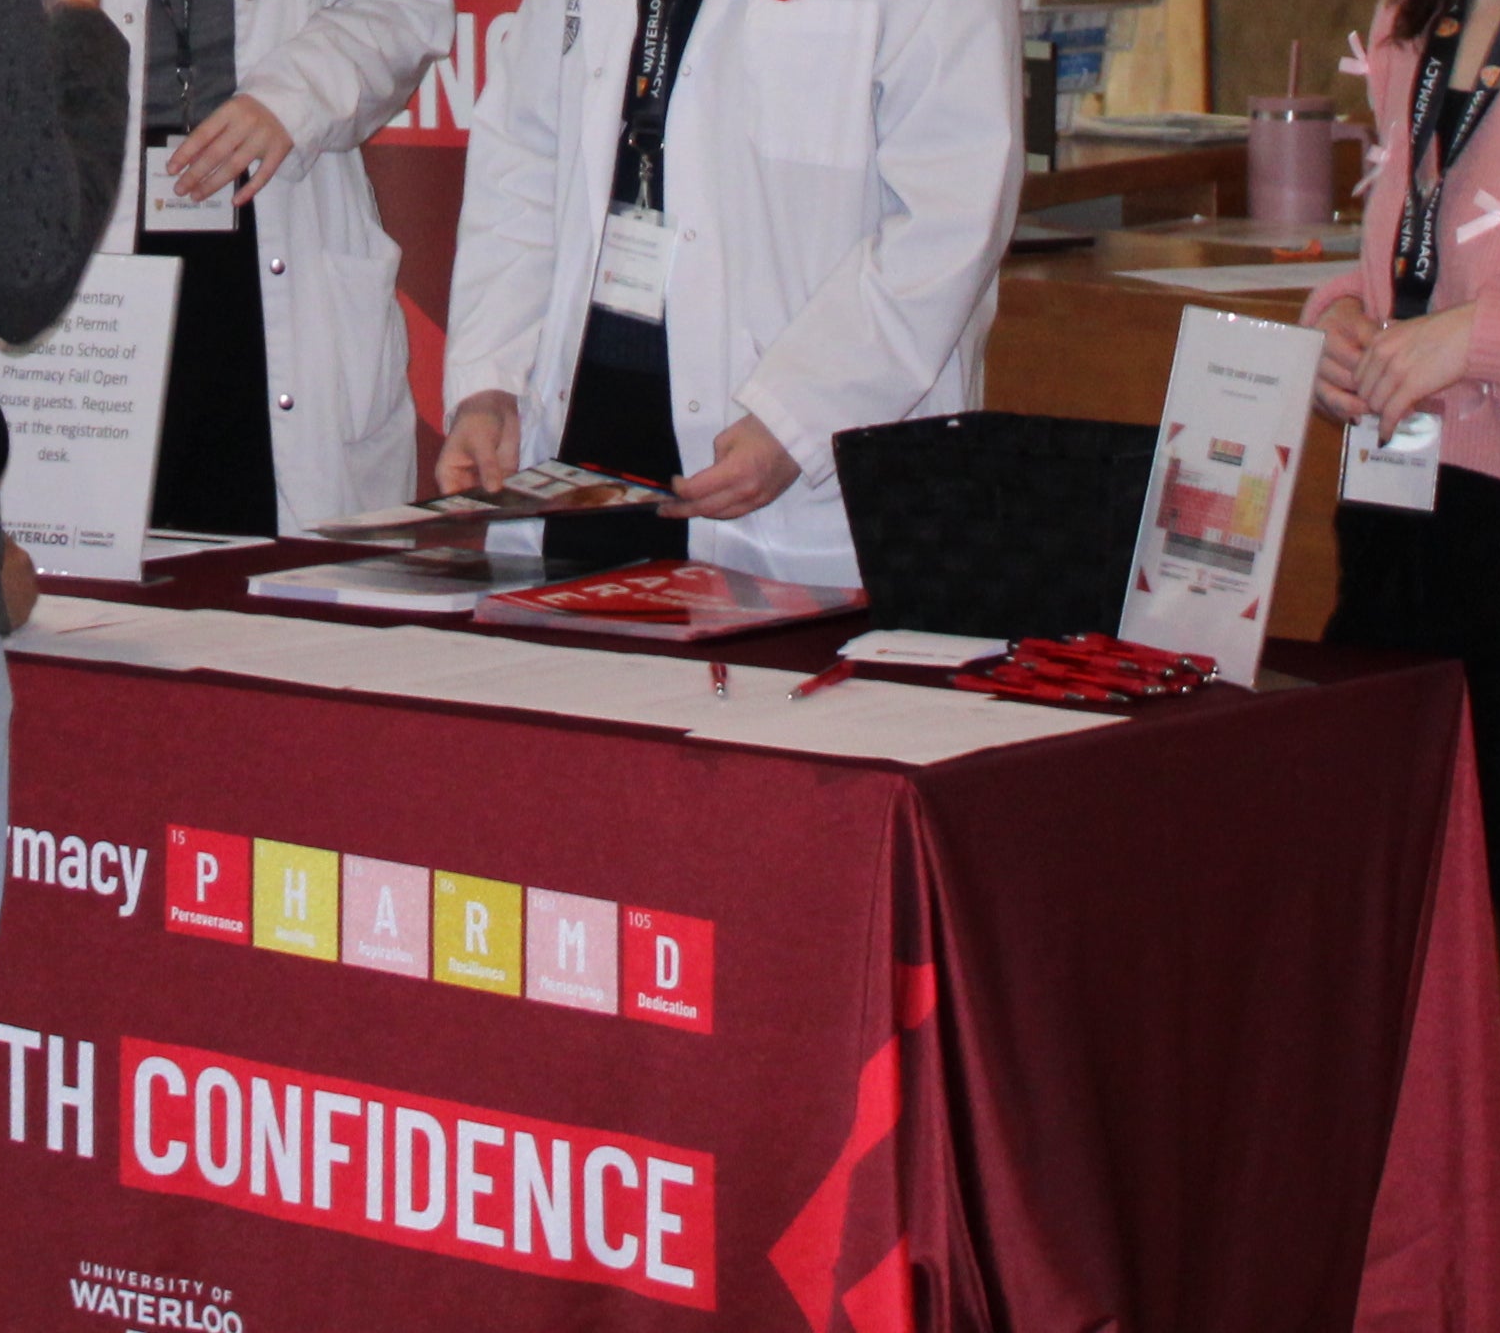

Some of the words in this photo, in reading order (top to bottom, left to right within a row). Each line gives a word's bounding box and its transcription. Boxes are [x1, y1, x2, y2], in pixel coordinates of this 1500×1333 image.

[1411, 56, 1442, 144] HARMACY
[76, 317, 118, 332] Permit
[60, 344, 74, 356] to
[77, 342, 119, 359] School
[122, 345, 136, 359] of
[2, 365, 65, 384] Pharmacy
[69, 368, 90, 383] Fall
[93, 371, 128, 386] Open
[33, 396, 77, 411] guests.
[82, 396, 133, 414] Request
[15, 421, 27, 433] at
[31, 420, 51, 434] the
[56, 423, 129, 440] registration
[38, 447, 71, 462] desk.
[7, 824, 148, 917] macy
[171, 830, 186, 845] 15
[628, 911, 651, 929] 105
[196, 851, 219, 902] P
[284, 867, 307, 921] H
[373, 884, 398, 937] A
[465, 901, 489, 955] R
[558, 918, 587, 973] M
[655, 935, 680, 989] D
[171, 906, 244, 933] Perseverance
[637, 992, 697, 1019] Dedication
[133, 1055, 695, 1288] CONFIDENCE
[69, 1278, 243, 1333] WATERLOO
[80, 1260, 203, 1295] UNIVERSITY
[211, 1286, 232, 1304] OF
